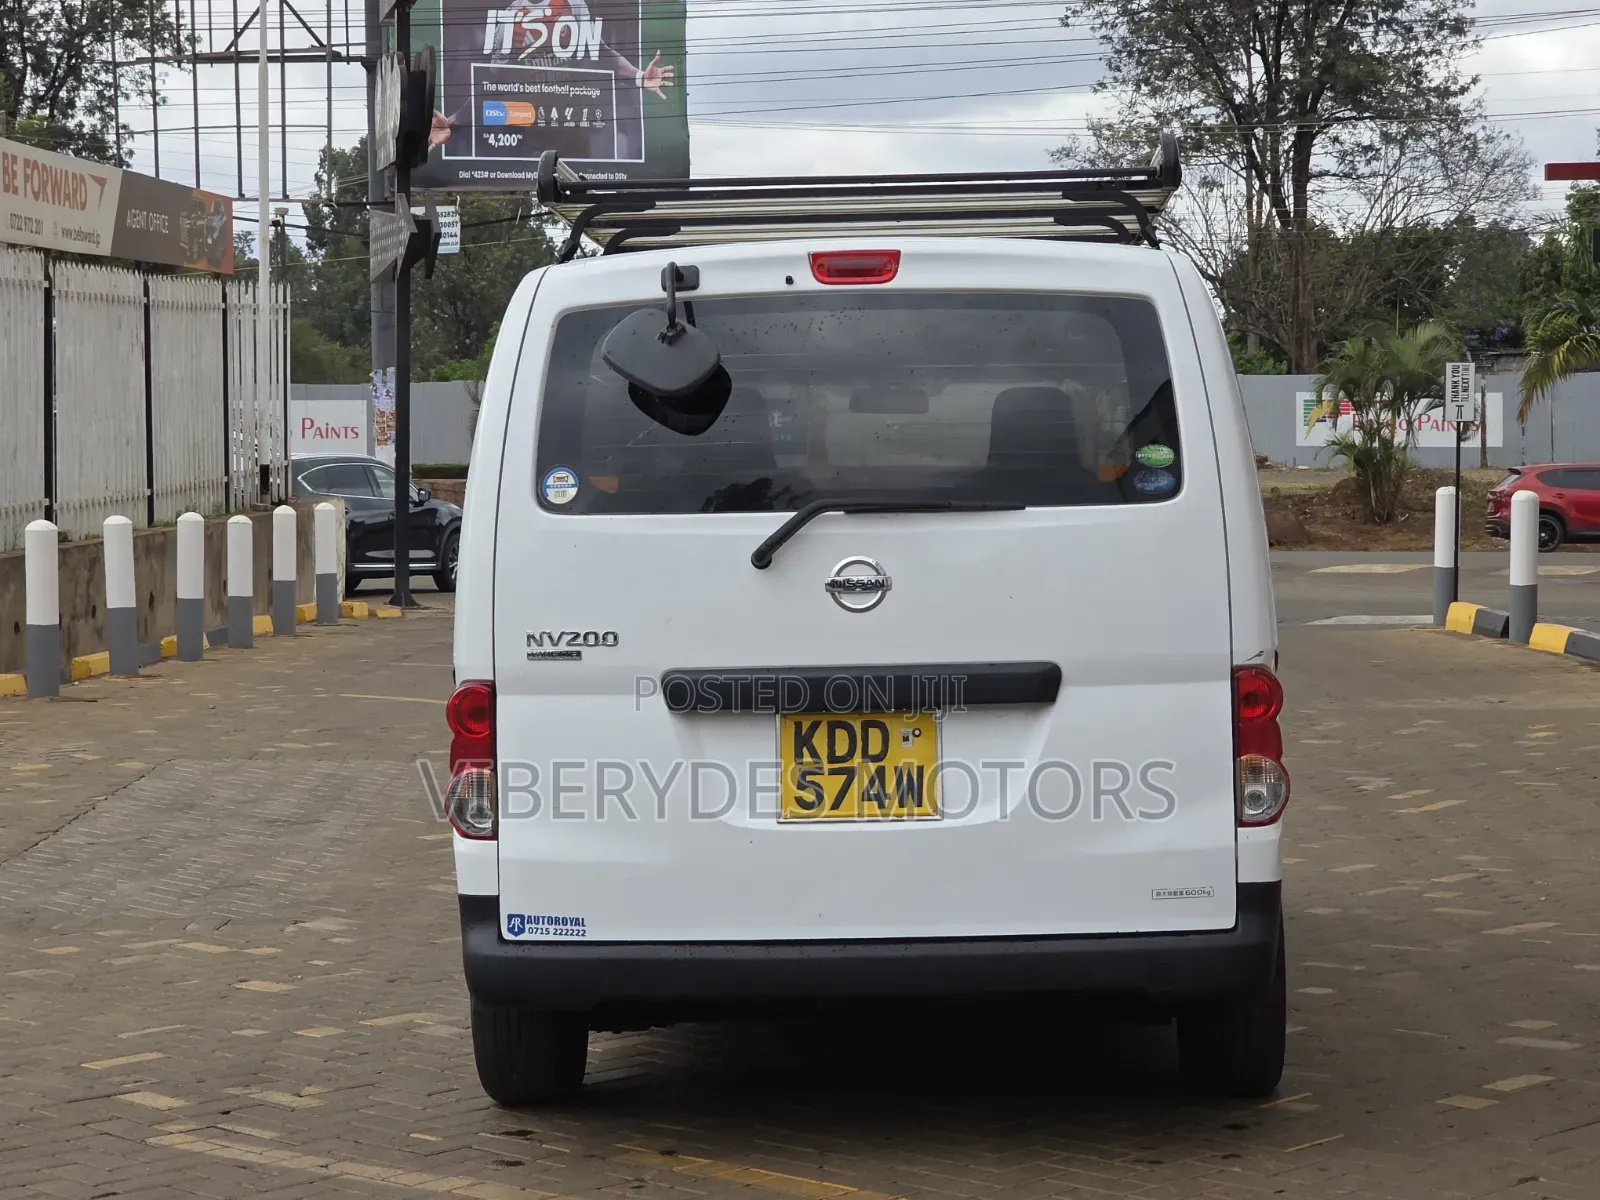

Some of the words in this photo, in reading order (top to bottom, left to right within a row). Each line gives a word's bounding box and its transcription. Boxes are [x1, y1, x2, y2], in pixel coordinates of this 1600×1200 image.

[552, 15, 603, 61] ON
[482, 81, 497, 91] The
[498, 82, 524, 93] world's
[525, 83, 541, 93] best
[541, 83, 569, 95] football
[570, 86, 601, 98] package
[488, 133, 518, 148] 4,200
[2, 151, 19, 197] BE
[23, 157, 88, 211] FORWARD
[458, 171, 471, 179] Dial
[496, 171, 526, 180] Download
[608, 172, 615, 180] to
[126, 208, 149, 230] AGENT
[148, 210, 169, 234] OFFICE
[1450, 364, 1461, 379] YOU
[1460, 364, 1471, 376] TIME
[1450, 379, 1461, 404] THANK
[1460, 376, 1470, 393] NEXT
[1417, 413, 1480, 432] PAINS
[829, 578, 886, 590] NISSAN
[526, 630, 620, 648] NV200
[793, 719, 890, 766] KDD
[793, 764, 925, 811] 574W
[526, 915, 587, 927] AUTOROYAL
[527, 926, 551, 936] 0715
[552, 927, 587, 937] 222222
